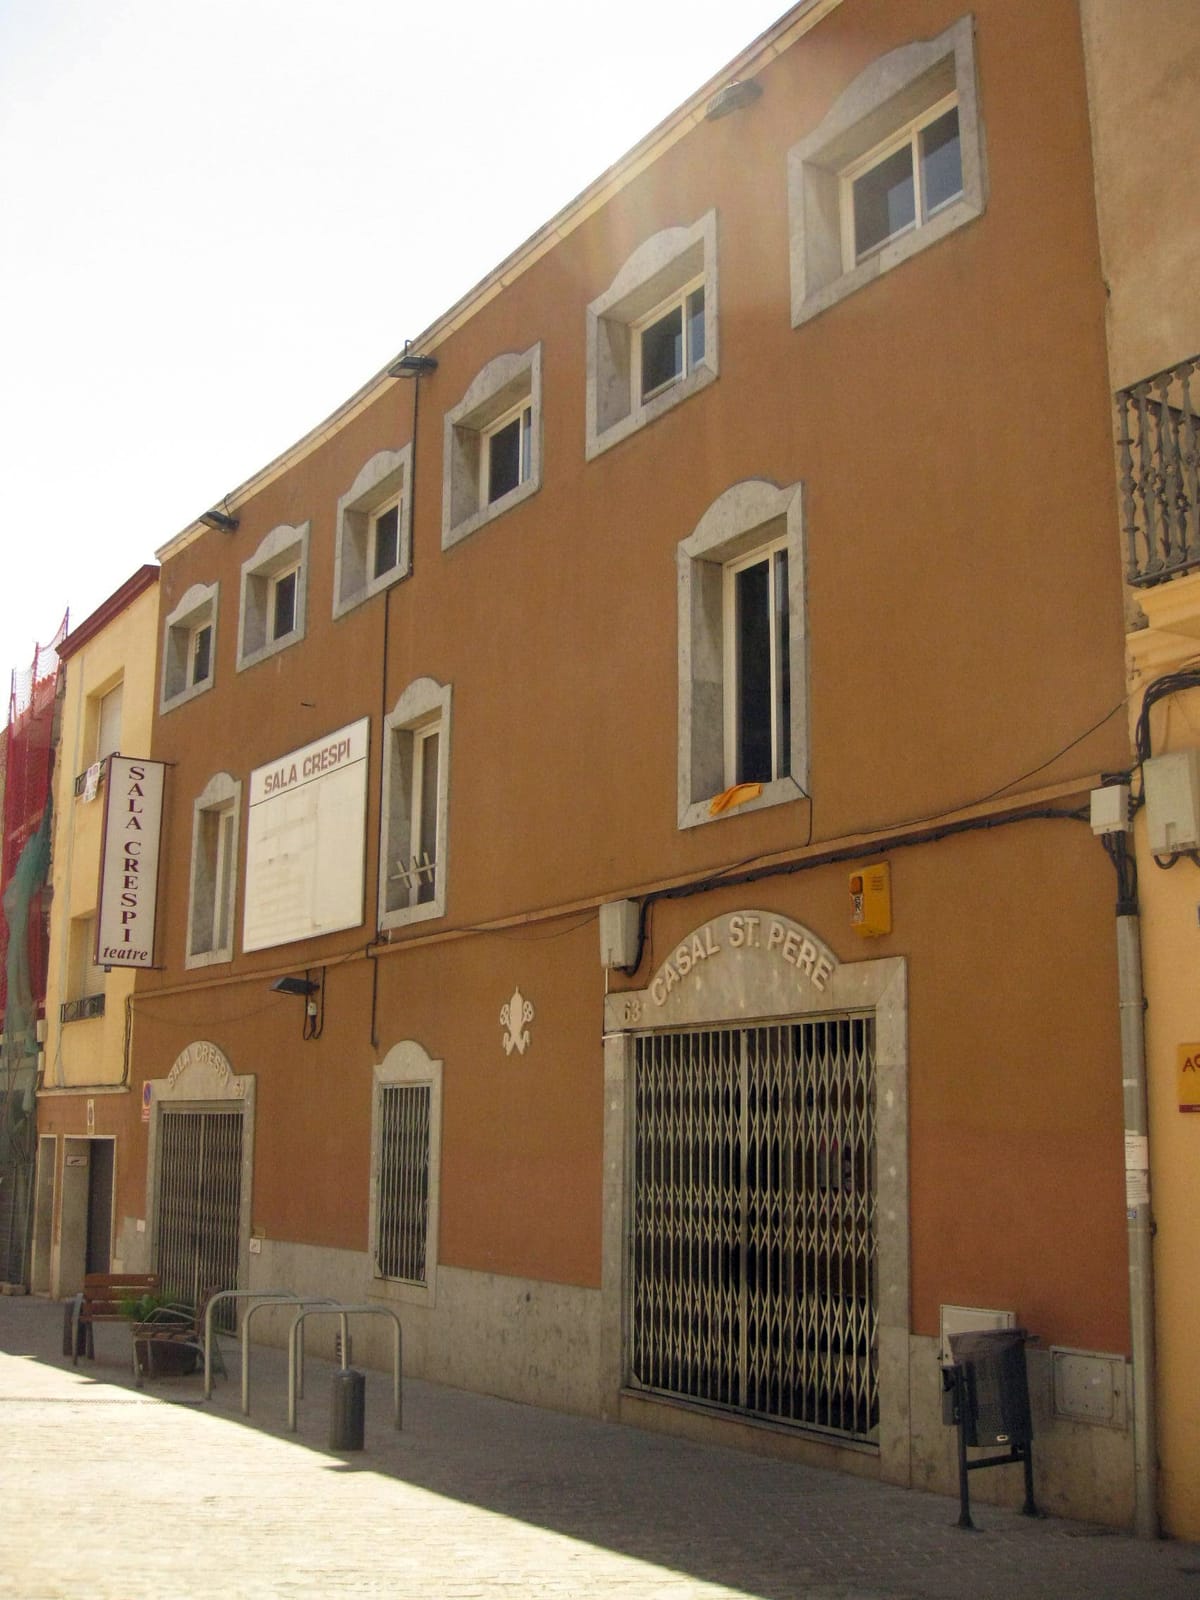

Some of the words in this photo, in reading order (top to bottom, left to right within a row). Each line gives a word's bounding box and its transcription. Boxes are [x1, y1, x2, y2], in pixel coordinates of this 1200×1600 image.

[264, 763, 298, 795] SALA
[302, 737, 351, 777] CRESPI
[125, 766, 145, 831] SALA
[120, 841, 142, 943] CRESPI
[103, 946, 148, 961] teatre
[651, 927, 721, 1007] CASAL
[728, 915, 761, 948] ST.
[766, 920, 836, 992] PERE
[168, 1047, 191, 1090] SALA
[195, 1044, 229, 1087] CRESPI
